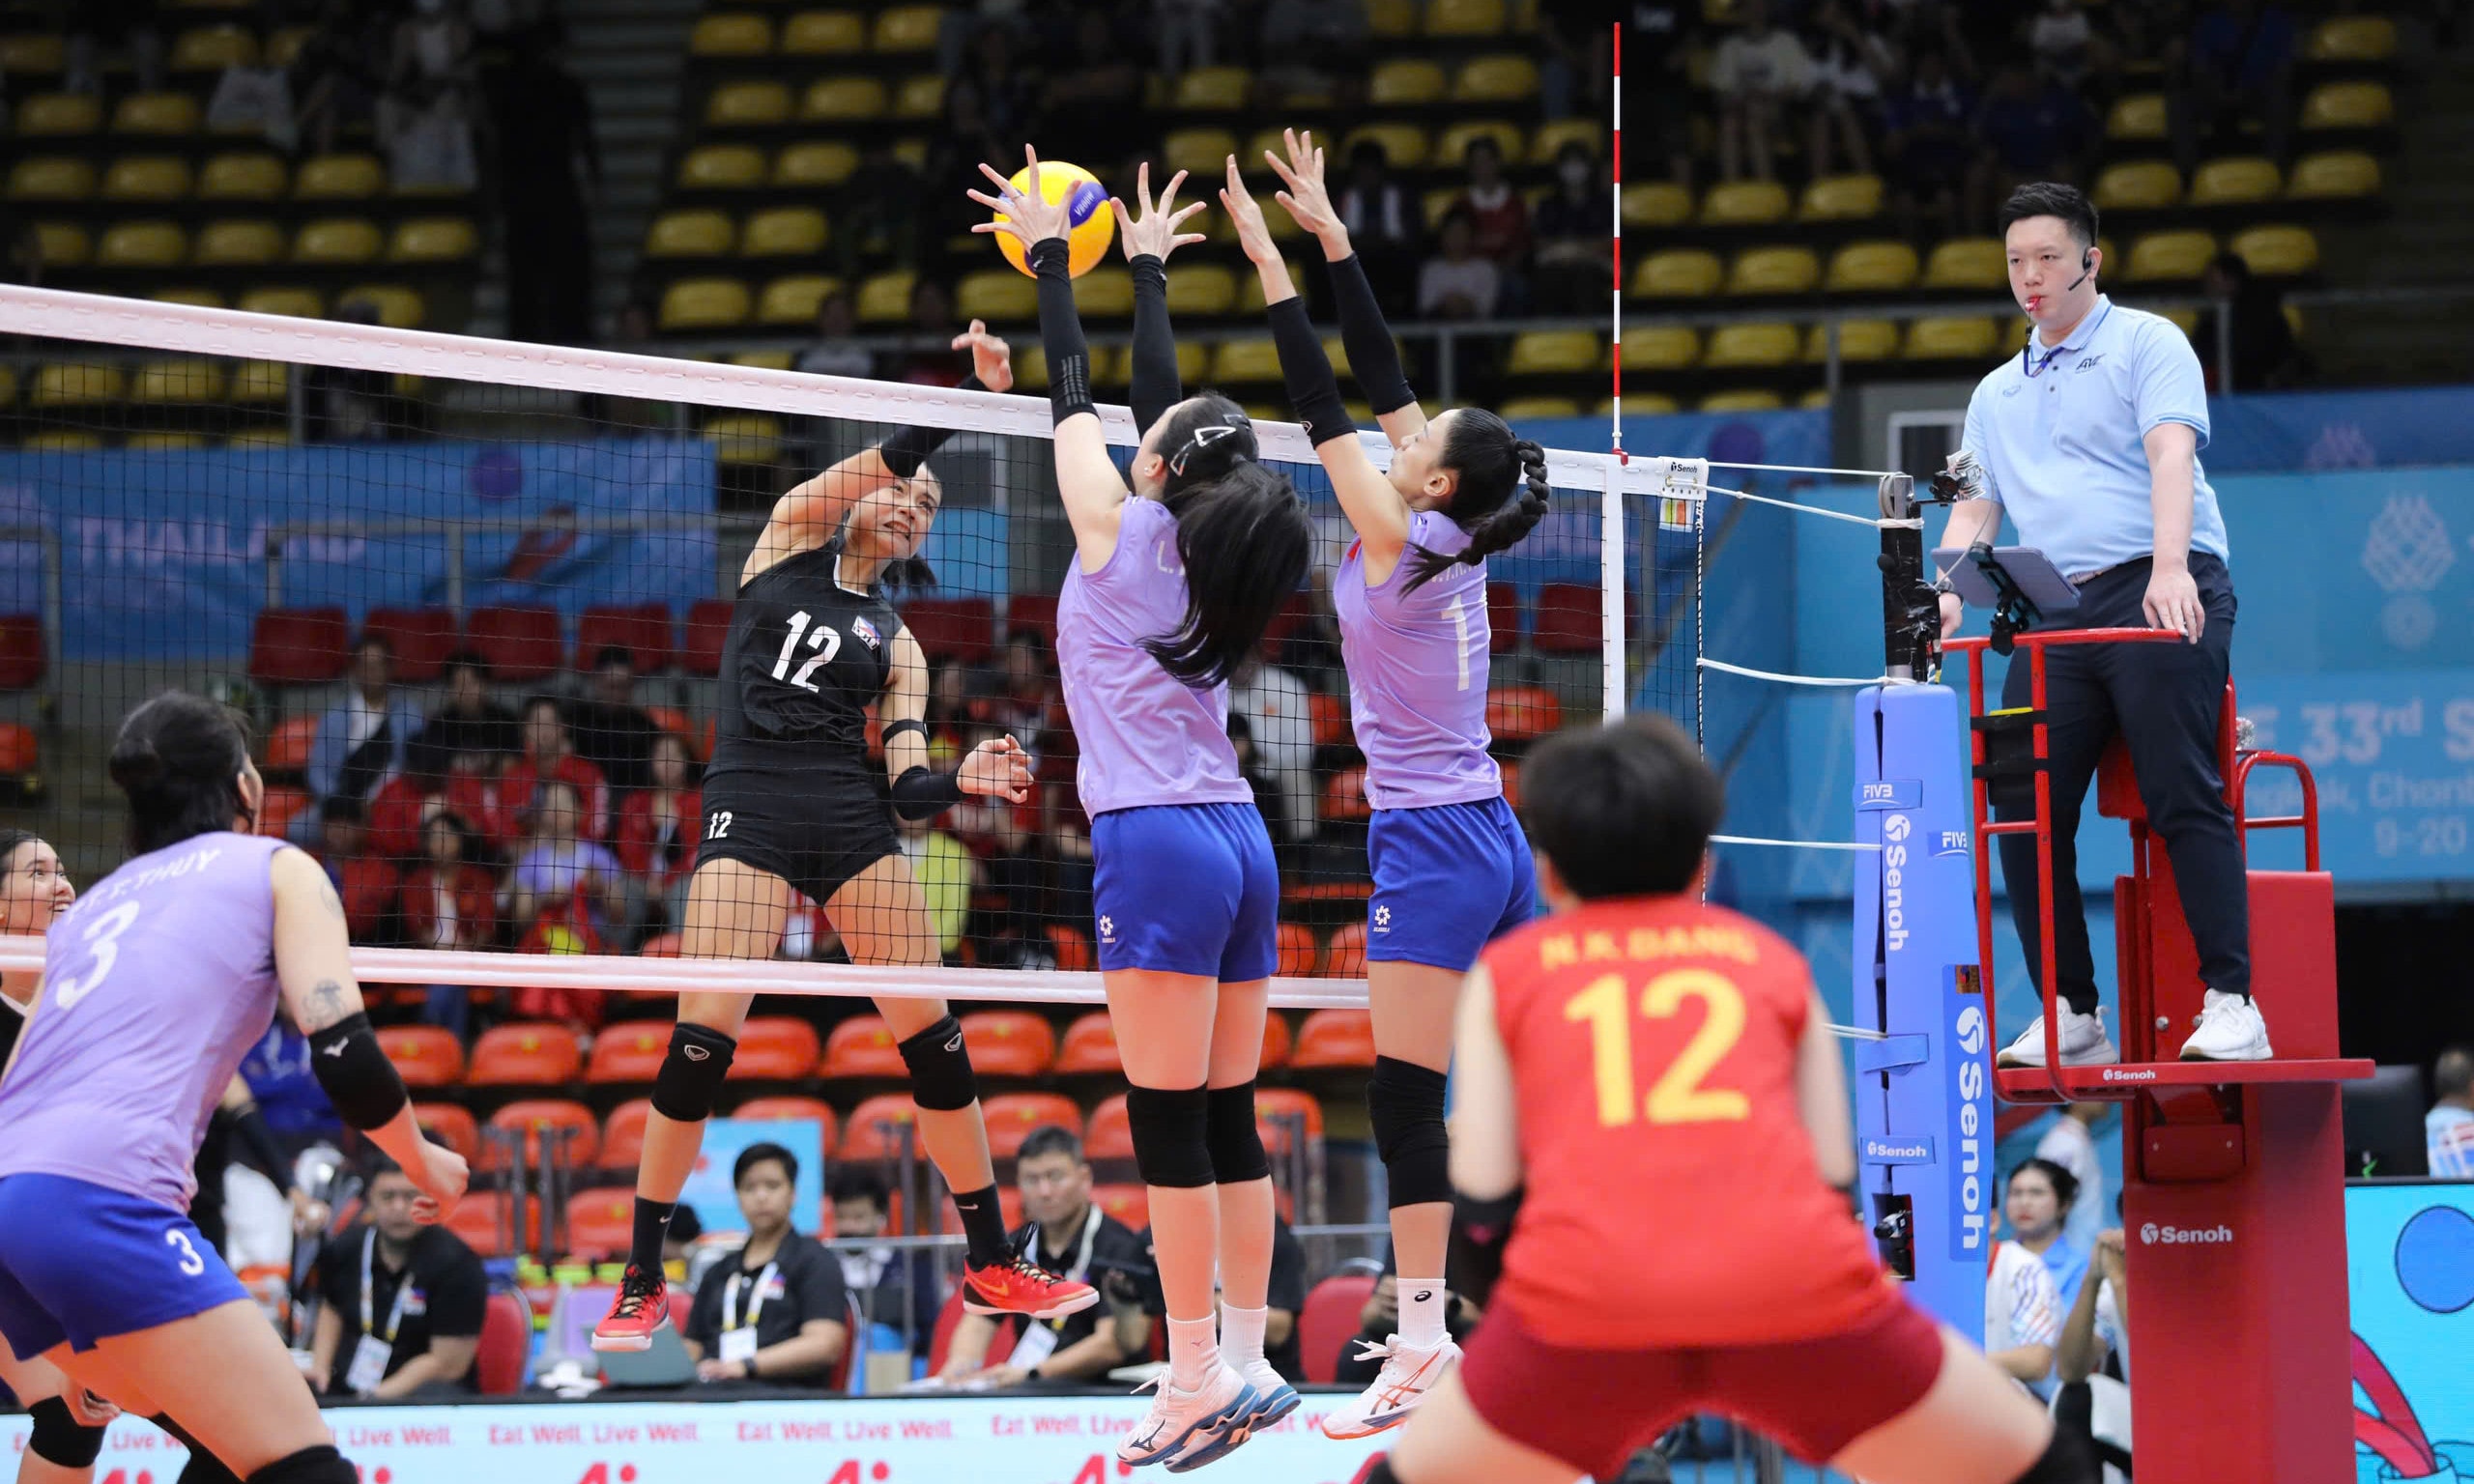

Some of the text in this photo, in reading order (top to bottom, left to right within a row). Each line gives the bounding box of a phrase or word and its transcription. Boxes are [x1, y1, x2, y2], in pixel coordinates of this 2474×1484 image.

[1677, 464, 1698, 473] Senoh
[771, 610, 841, 693] 12
[1441, 594, 1470, 692] 1
[2301, 699, 2423, 765] 33rd
[1863, 785, 1893, 798] FIVB
[708, 812, 733, 839] 12
[2374, 817, 2467, 857] 9-20
[1886, 844, 1909, 951] Senoh
[56, 899, 140, 1011] 3
[1564, 967, 1750, 1127] 12
[2114, 1070, 2156, 1080] Senoh
[1878, 1145, 1927, 1157] Senoh
[1959, 1061, 1984, 1249] Senoh
[2161, 1225, 2232, 1243] Senoh
[166, 1229, 204, 1275] 3
[349, 1426, 392, 1446] Live
[489, 1424, 523, 1445] Eat
[592, 1423, 639, 1444] Live
[737, 1421, 772, 1441] Eat
[845, 1420, 890, 1441] Live
[992, 1414, 1023, 1437] Eat
[112, 1432, 156, 1450] Live
